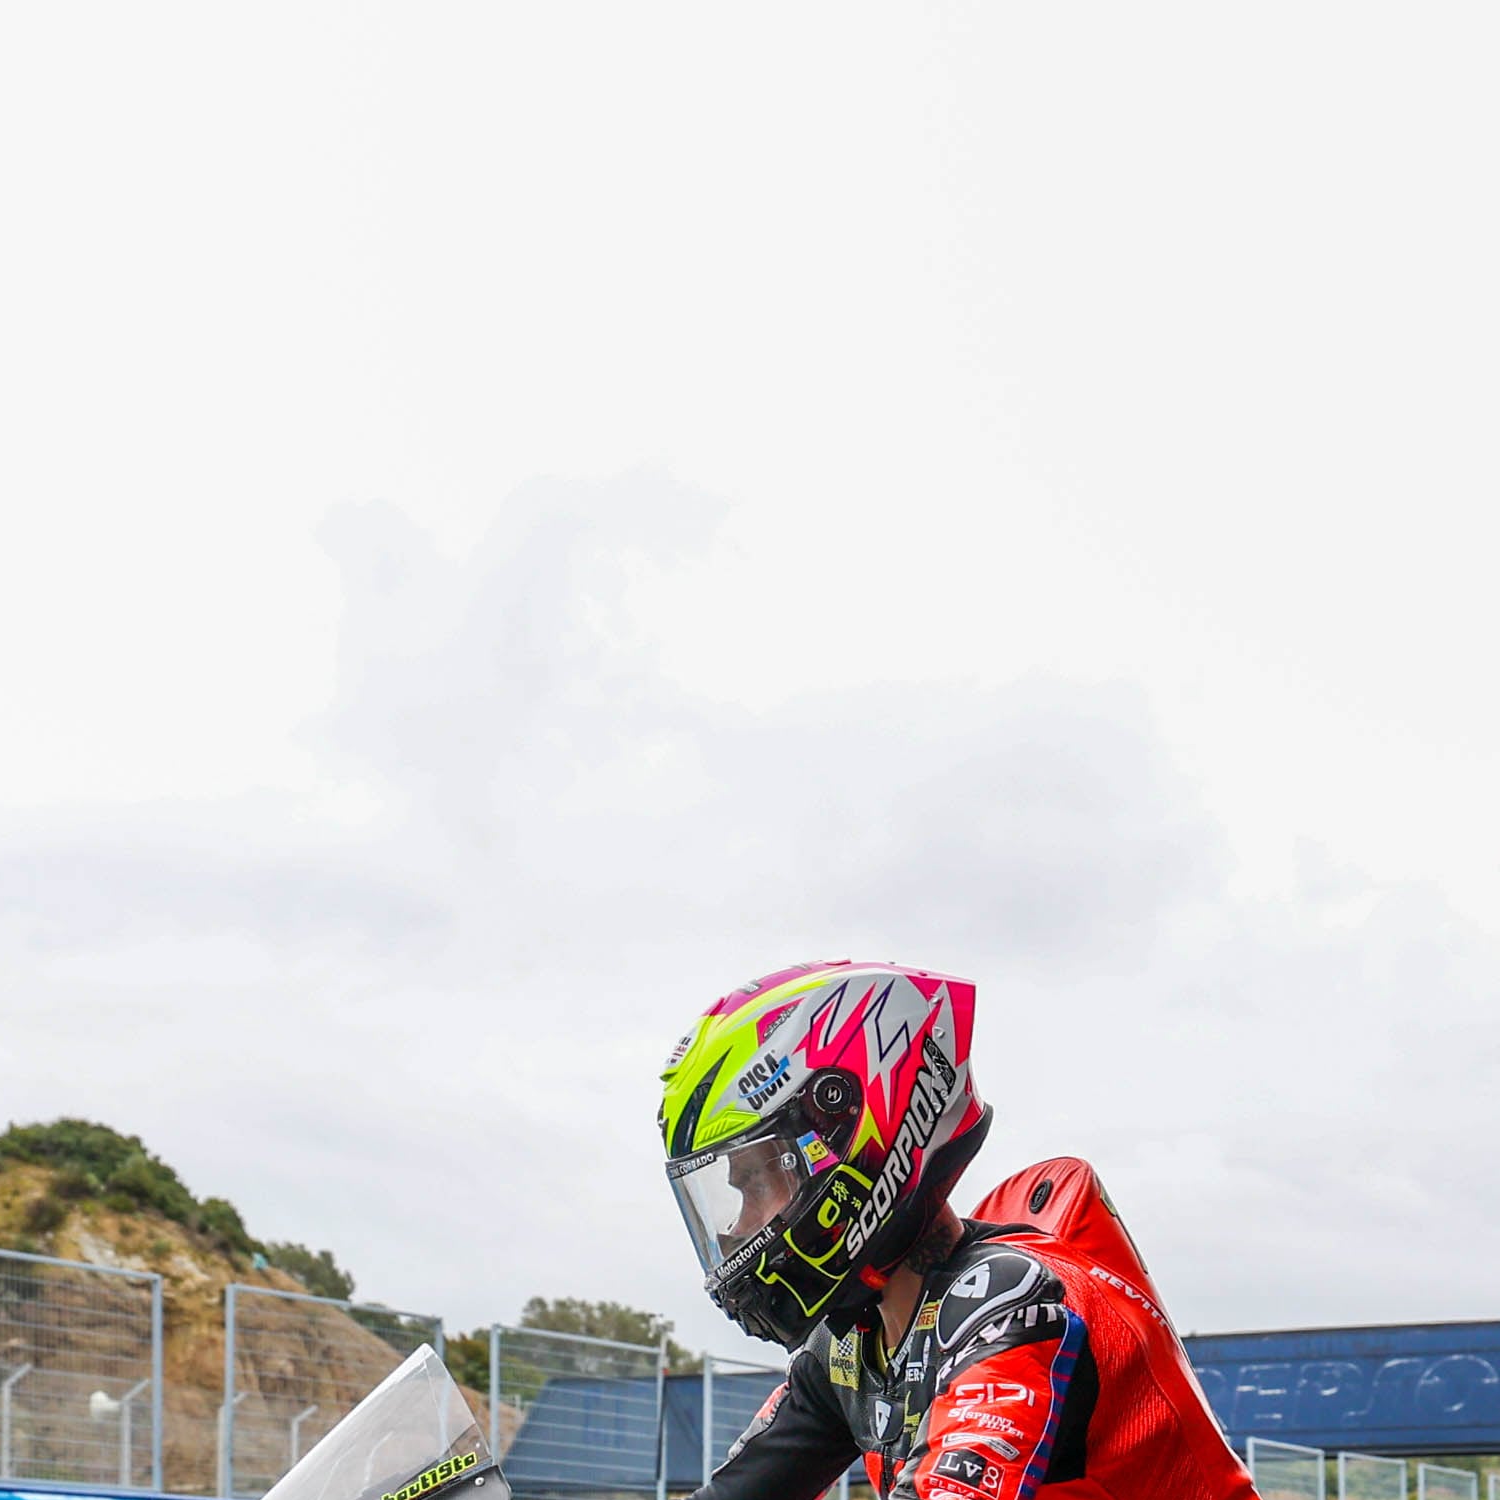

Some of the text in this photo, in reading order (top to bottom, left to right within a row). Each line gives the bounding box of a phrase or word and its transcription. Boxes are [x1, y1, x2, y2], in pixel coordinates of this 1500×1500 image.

[737, 1051, 792, 1111] CISA
[716, 1226, 776, 1279] Motostorm.it
[955, 1383, 1035, 1408] SIDI
[965, 1410, 1015, 1427] SPRINT
[978, 1419, 1025, 1440] FILTER
